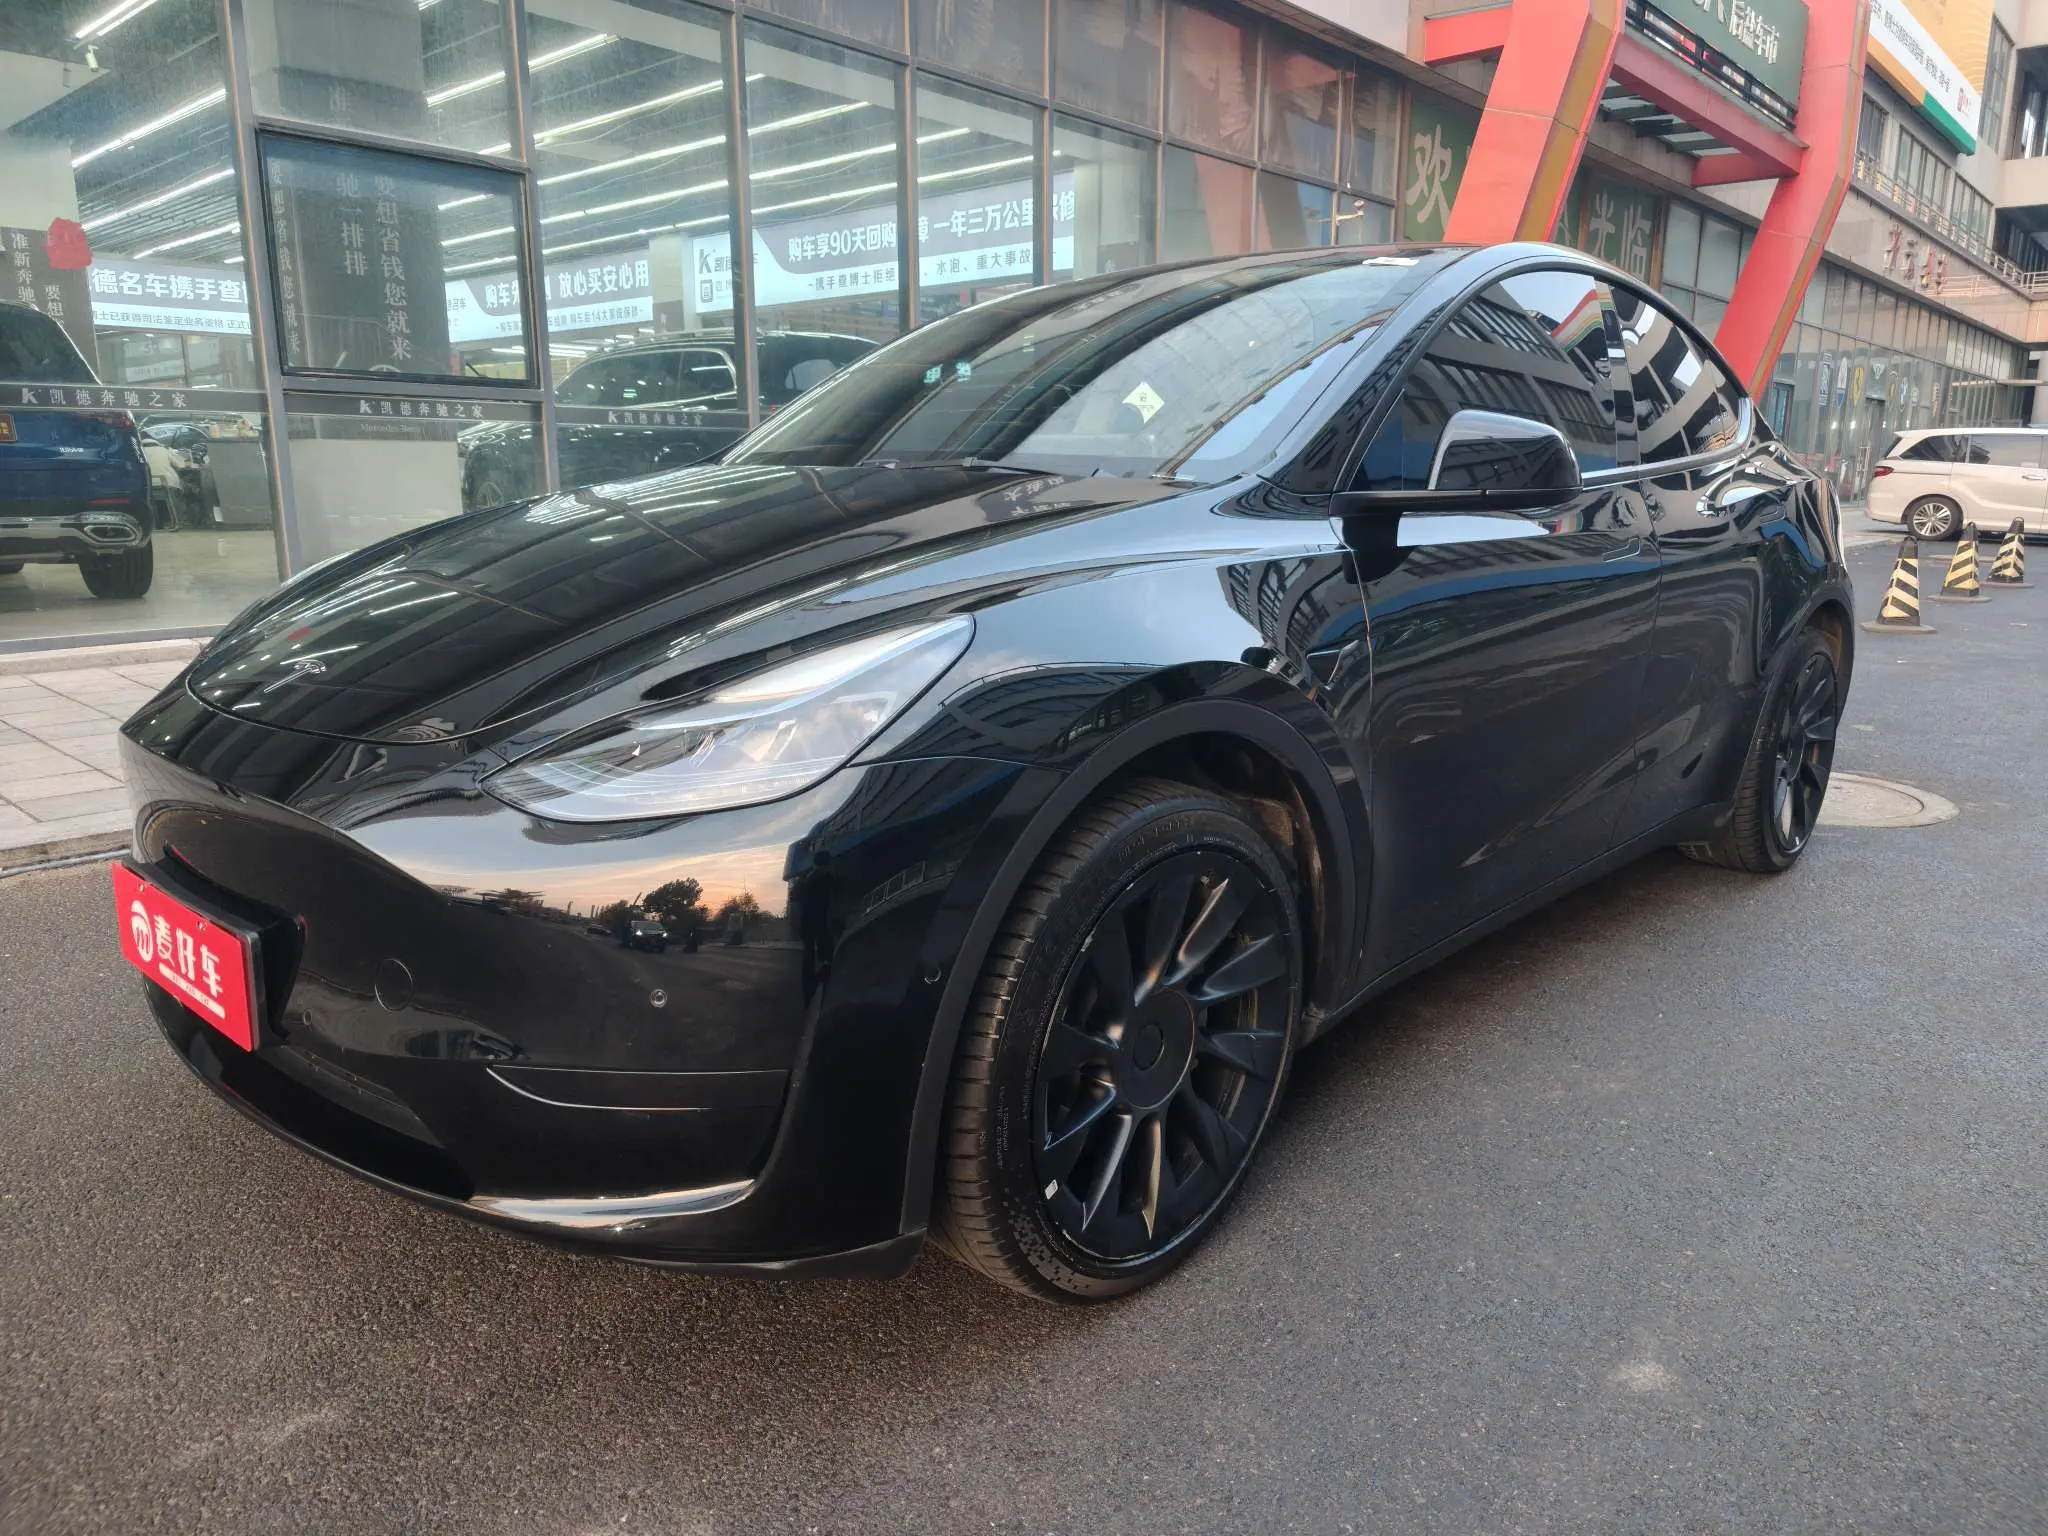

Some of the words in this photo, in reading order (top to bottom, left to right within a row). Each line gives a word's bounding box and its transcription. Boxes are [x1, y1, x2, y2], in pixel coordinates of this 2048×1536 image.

[89, 267, 249, 305] 德名车携手查
[374, 174, 412, 361] 要想省钱您就来
[558, 259, 649, 298] 放心买安心用
[50, 388, 187, 408] 凯德奔驰之家
[380, 400, 484, 419] 凯德奔驰之家
[153, 913, 224, 998] 麦好车
